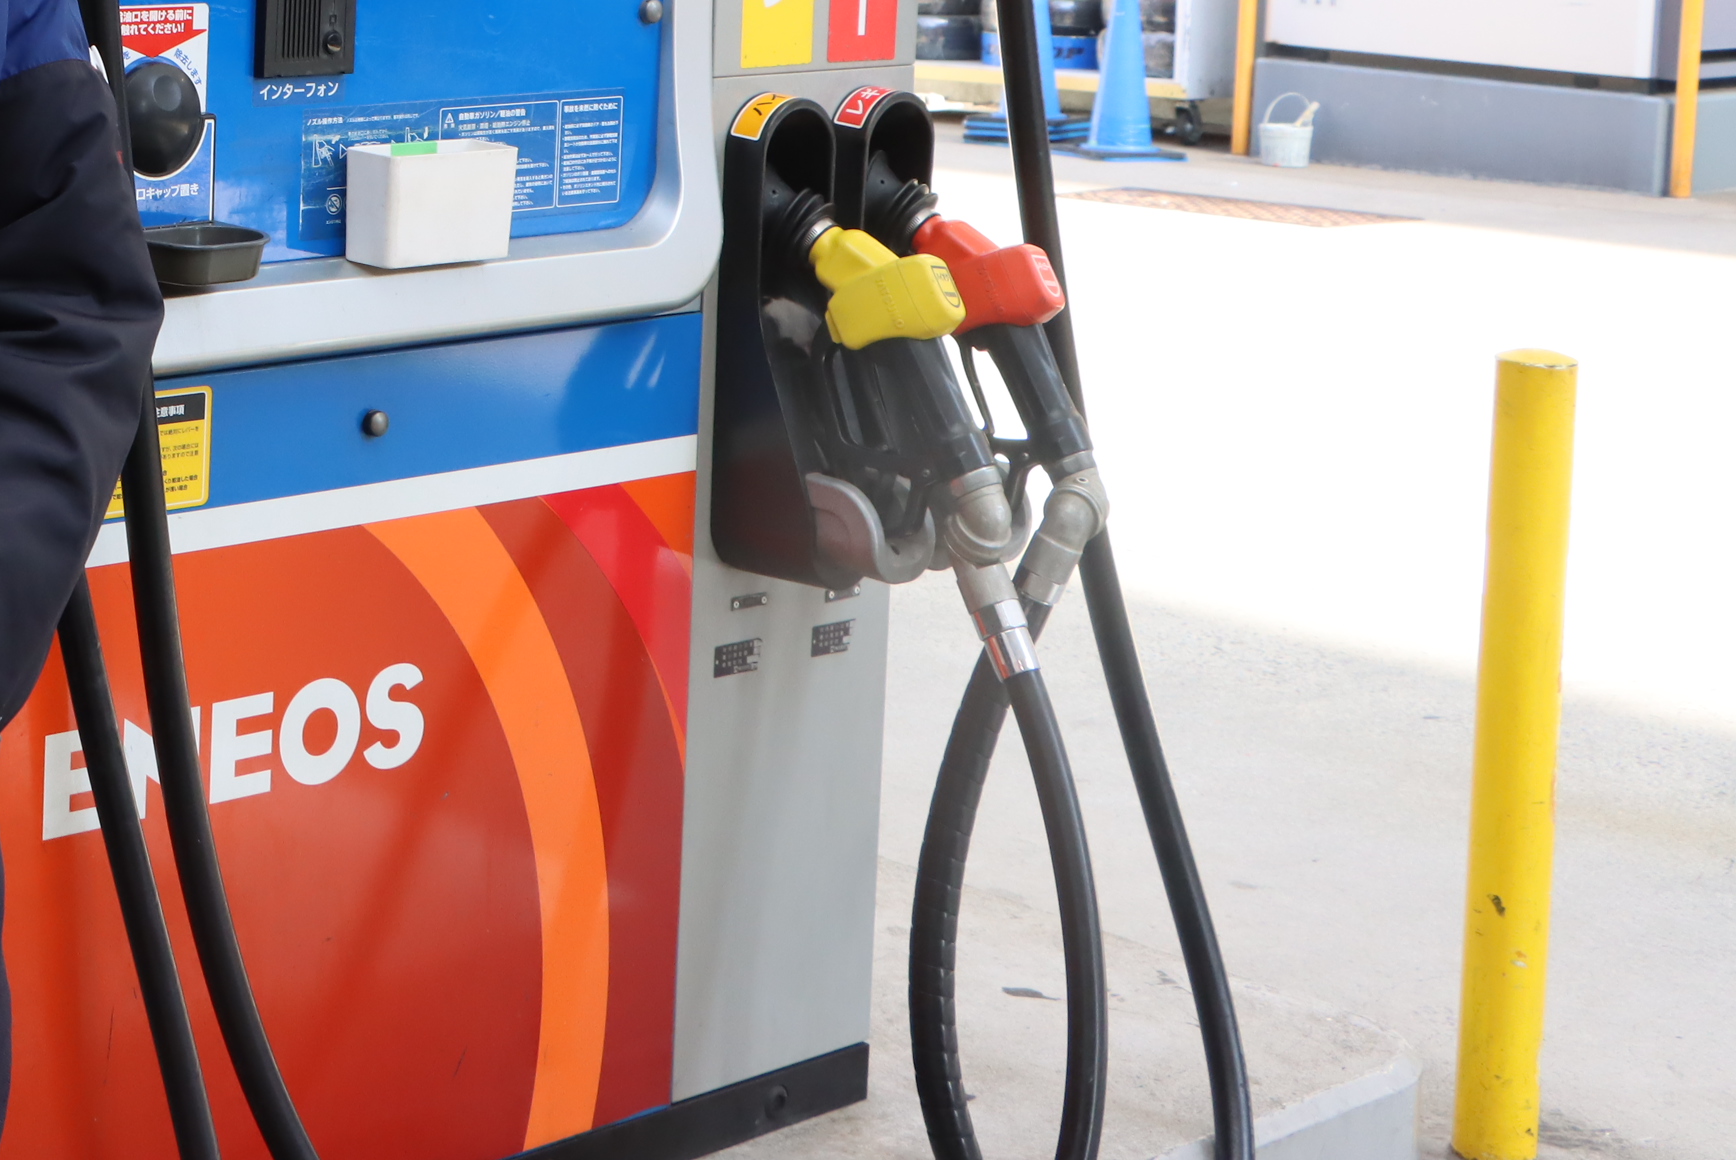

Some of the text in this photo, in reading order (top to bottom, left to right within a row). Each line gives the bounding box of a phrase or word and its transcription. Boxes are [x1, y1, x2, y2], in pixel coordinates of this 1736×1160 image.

[173, 47, 203, 85] 除去します
[259, 81, 340, 102] インターフォン
[135, 183, 200, 201] 口キャップ置き
